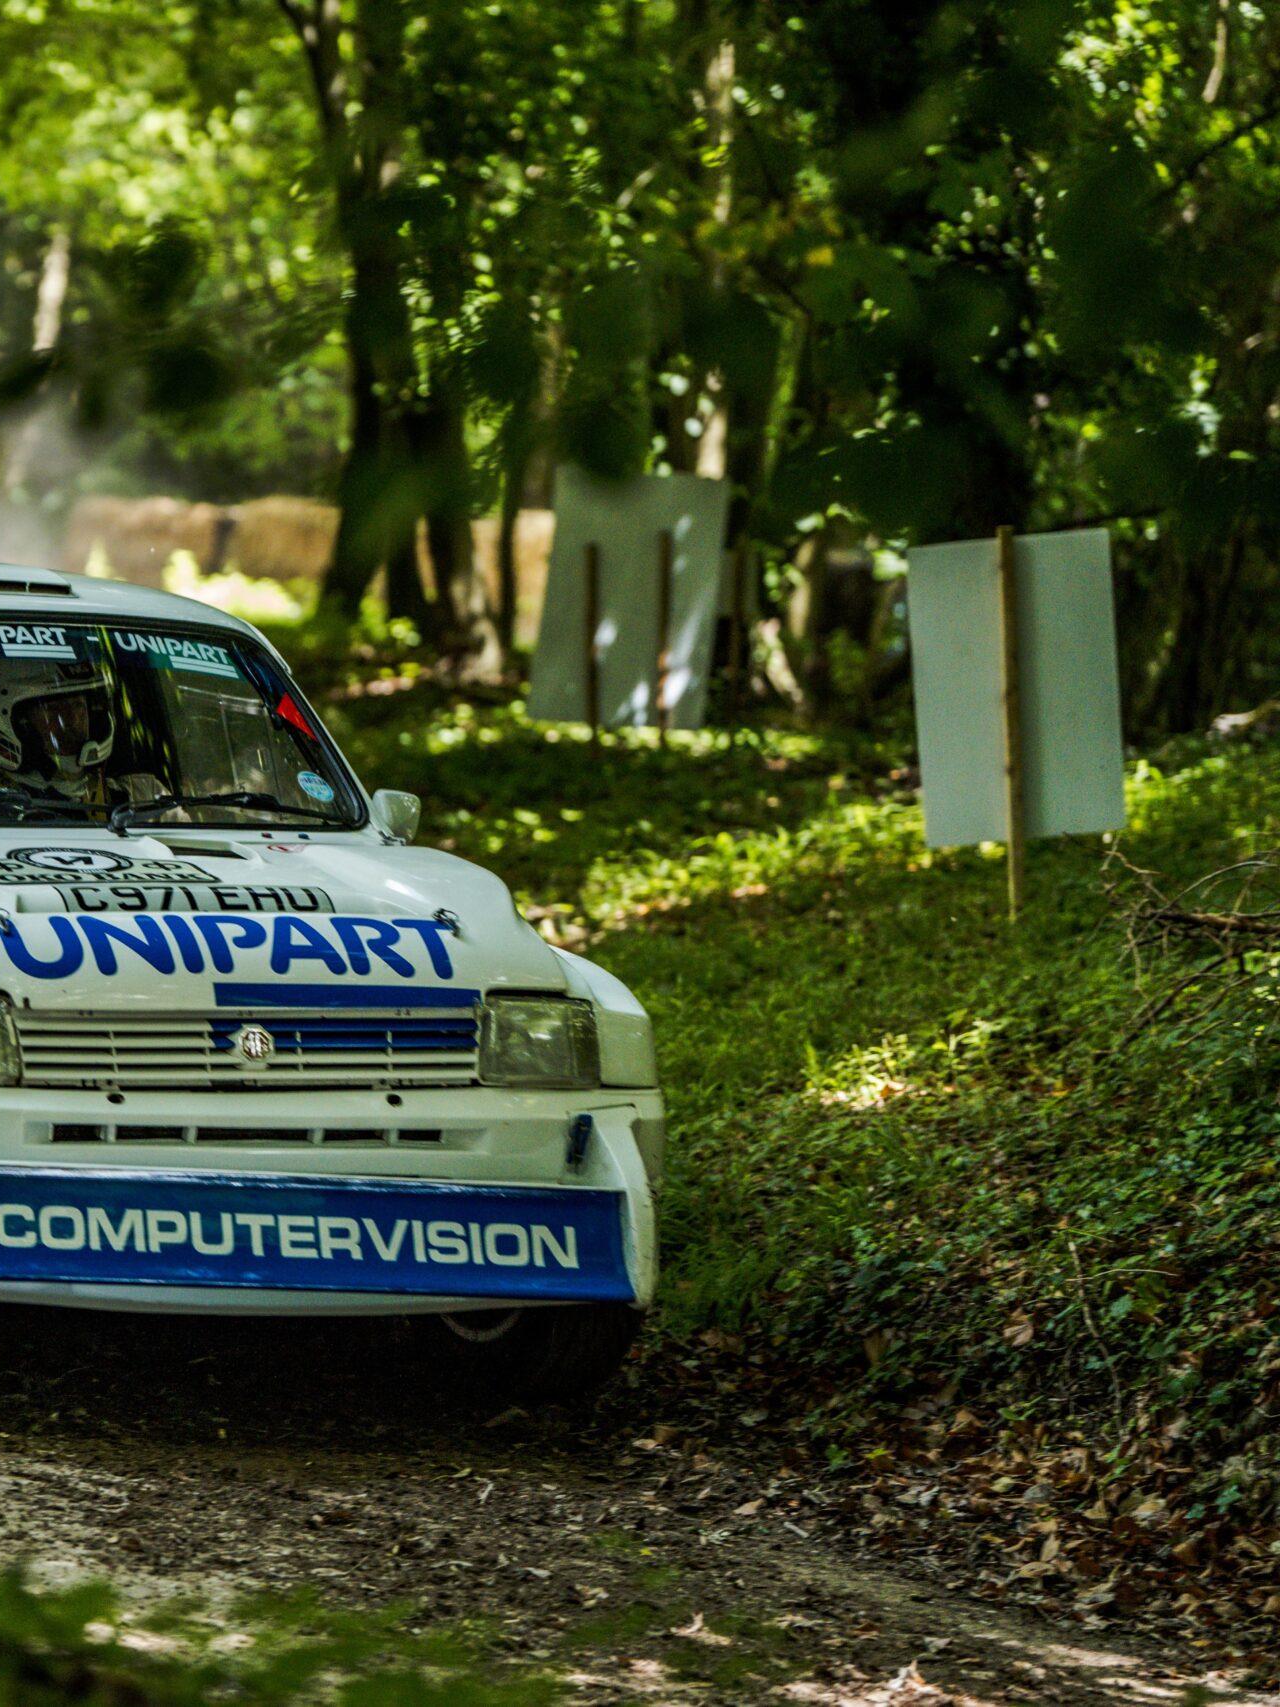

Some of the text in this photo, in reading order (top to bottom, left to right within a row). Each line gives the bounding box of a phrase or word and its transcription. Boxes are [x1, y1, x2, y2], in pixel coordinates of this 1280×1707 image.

[114, 631, 228, 666] UNIPART
[72, 886, 319, 912] C971 EHU
